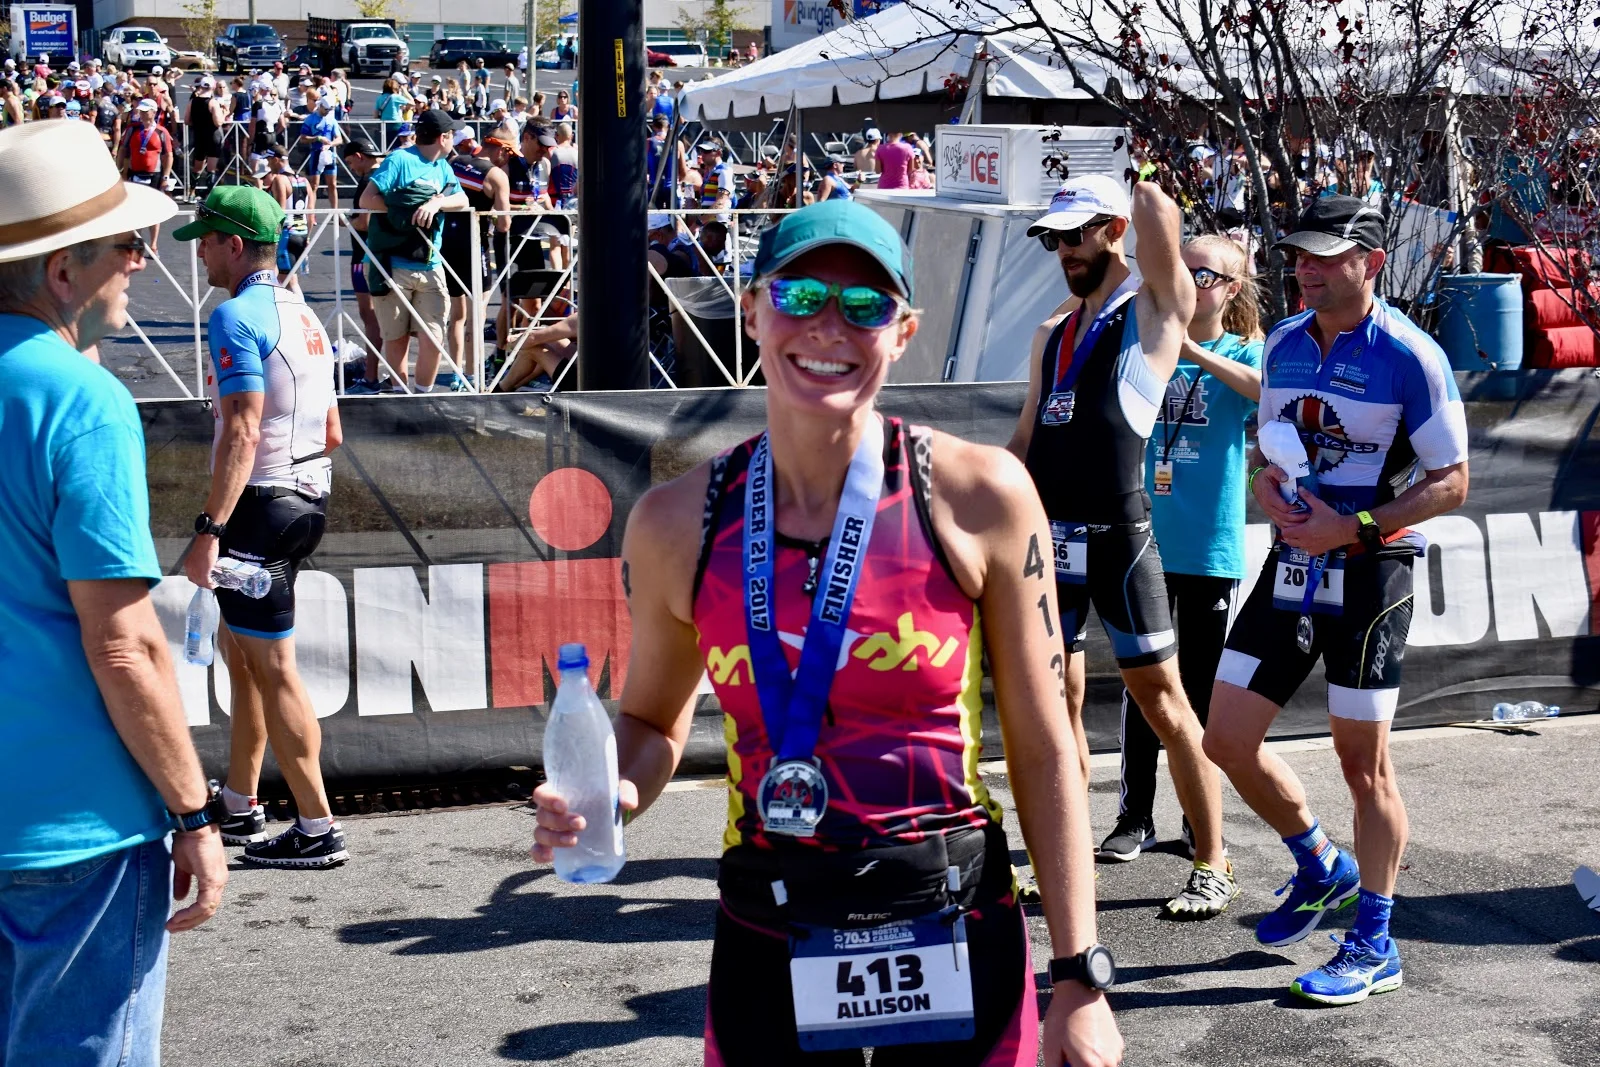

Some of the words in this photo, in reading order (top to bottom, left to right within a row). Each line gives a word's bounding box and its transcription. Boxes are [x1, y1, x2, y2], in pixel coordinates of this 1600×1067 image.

[30, 12, 67, 25] Budget
[970, 144, 999, 185] ICE
[236, 272, 272, 296] NISHER
[1278, 367, 1313, 375] CARPENTRY
[1345, 370, 1369, 379] HARDWOOD
[1347, 364, 1362, 372] FISHER
[1314, 432, 1375, 452] CYCLES
[751, 433, 769, 535] OCTOBER
[747, 540, 768, 574] 21,
[820, 516, 865, 625] FINISHER
[1283, 566, 1330, 589] 201
[750, 576, 770, 631] 2017
[847, 912, 888, 920] FITLETIC
[843, 931, 871, 945] 70.3
[872, 926, 899, 937] NORTH
[872, 930, 914, 942] CAROLINA
[836, 954, 925, 997] 413
[837, 993, 931, 1020] ALLISON
